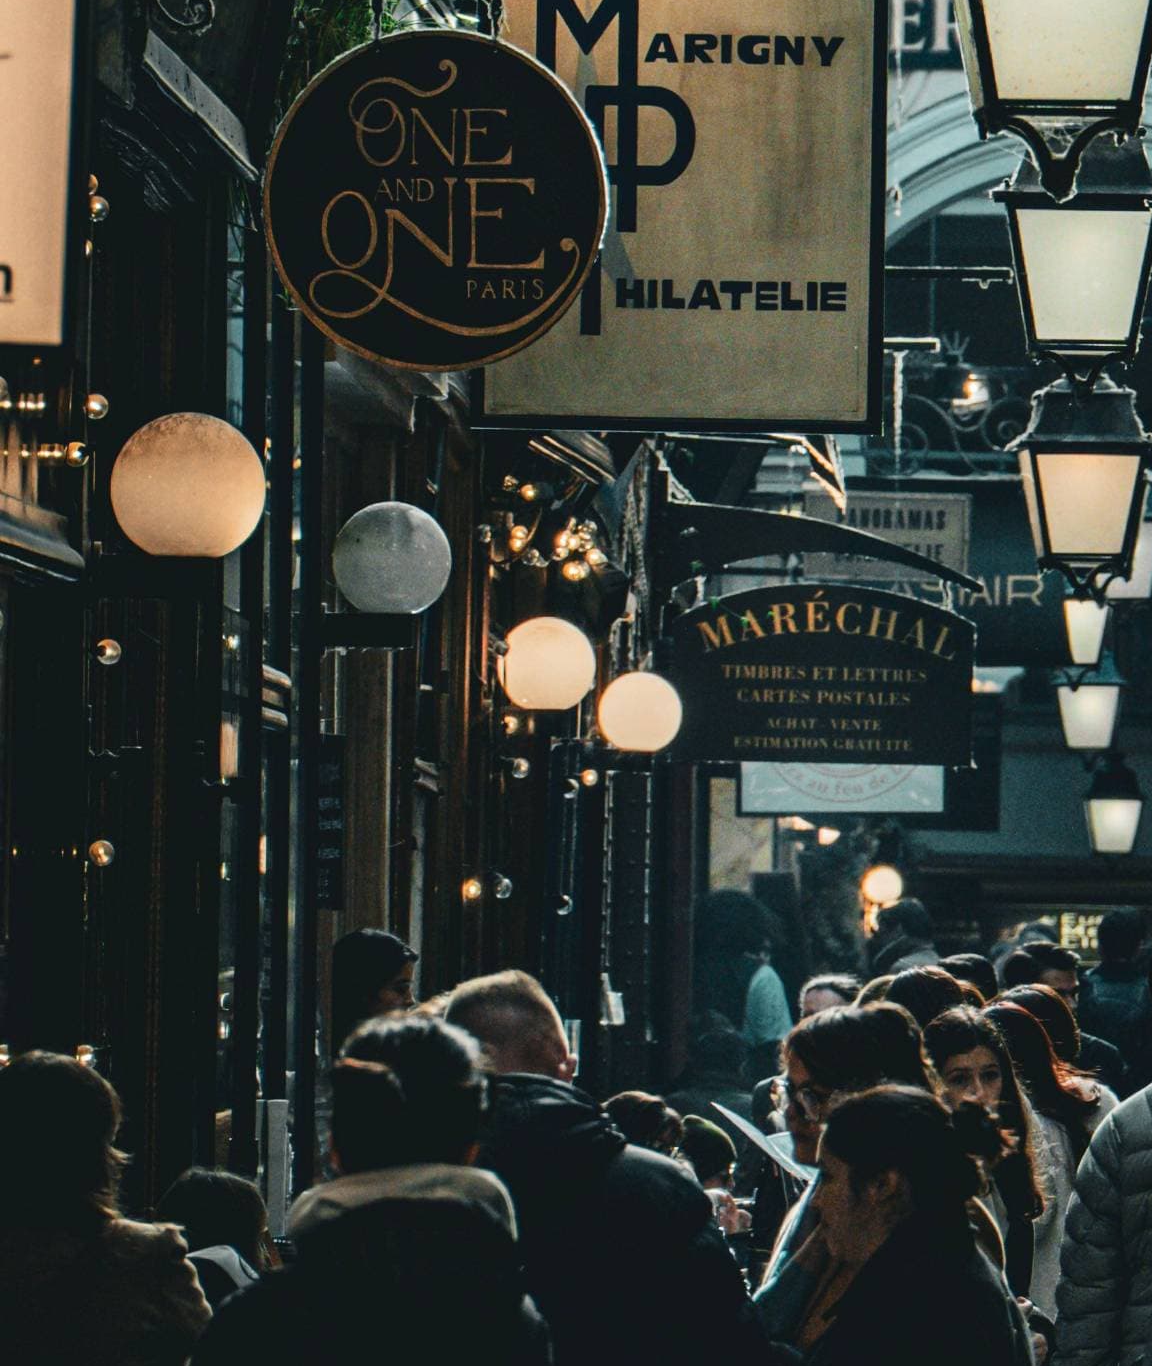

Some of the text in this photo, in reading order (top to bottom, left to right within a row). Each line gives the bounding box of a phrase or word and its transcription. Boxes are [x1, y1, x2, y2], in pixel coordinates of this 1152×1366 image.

[349, 58, 513, 167] ONE
[375, 178, 436, 203] AND
[466, 278, 545, 300] PARIS
[696, 588, 958, 661] MARÉCHAL
[720, 663, 928, 684] TIMBRES ET LETTRES
[735, 688, 912, 707] CARTES POSTALES
[767, 716, 818, 731] ACHAT
[830, 718, 883, 732] VENTE
[733, 735, 913, 753] ESTIMATION GRATUITE
